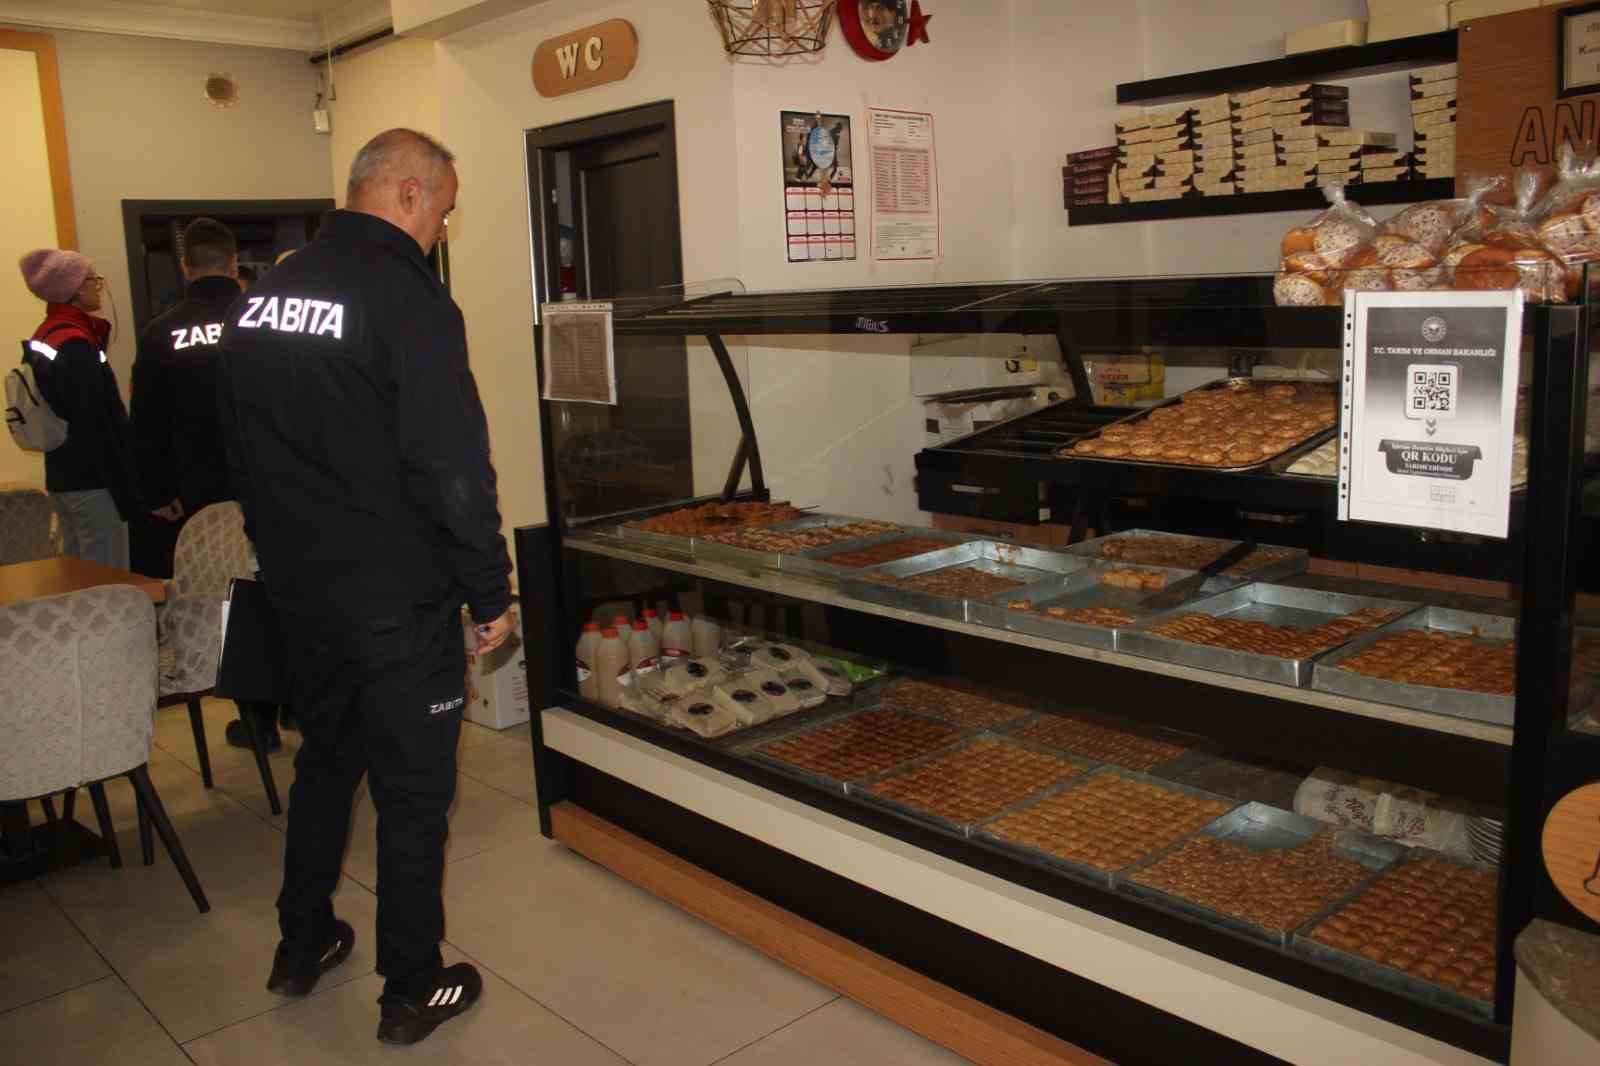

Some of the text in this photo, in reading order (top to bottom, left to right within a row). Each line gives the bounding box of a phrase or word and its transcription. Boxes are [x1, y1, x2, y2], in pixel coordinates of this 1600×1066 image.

[556, 36, 603, 80] WC
[237, 296, 344, 339] ZABITA
[171, 321, 224, 350] ZAB
[1412, 347, 1423, 355] VE
[1401, 450, 1458, 465] QR KODU
